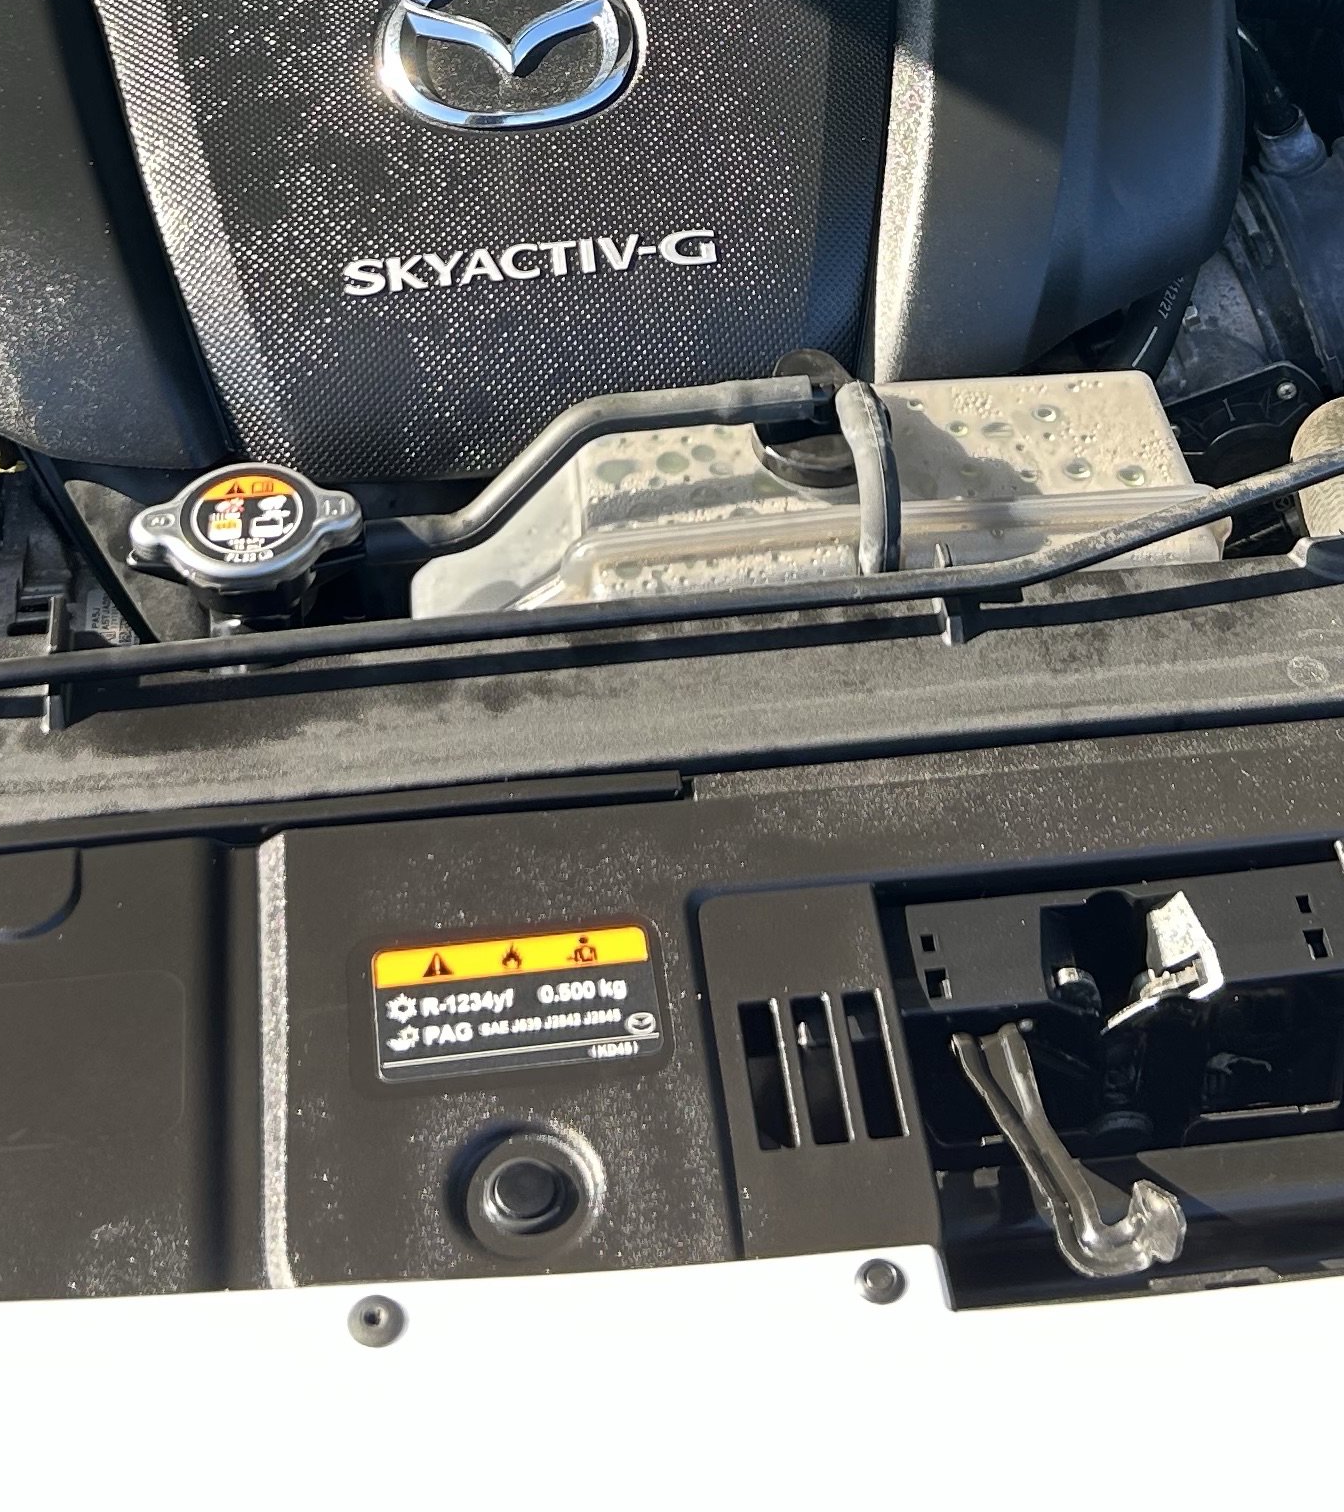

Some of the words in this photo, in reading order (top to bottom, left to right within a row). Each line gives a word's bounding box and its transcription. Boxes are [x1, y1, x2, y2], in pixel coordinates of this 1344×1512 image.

[342, 230, 718, 296] SKYACTIV-G
[322, 498, 346, 516] 1.1
[420, 988, 514, 1017] R-1234yf
[537, 981, 596, 1003] 0.500
[597, 978, 627, 1000] kg
[423, 1022, 474, 1046] PAG
[478, 1020, 509, 1036] SAE
